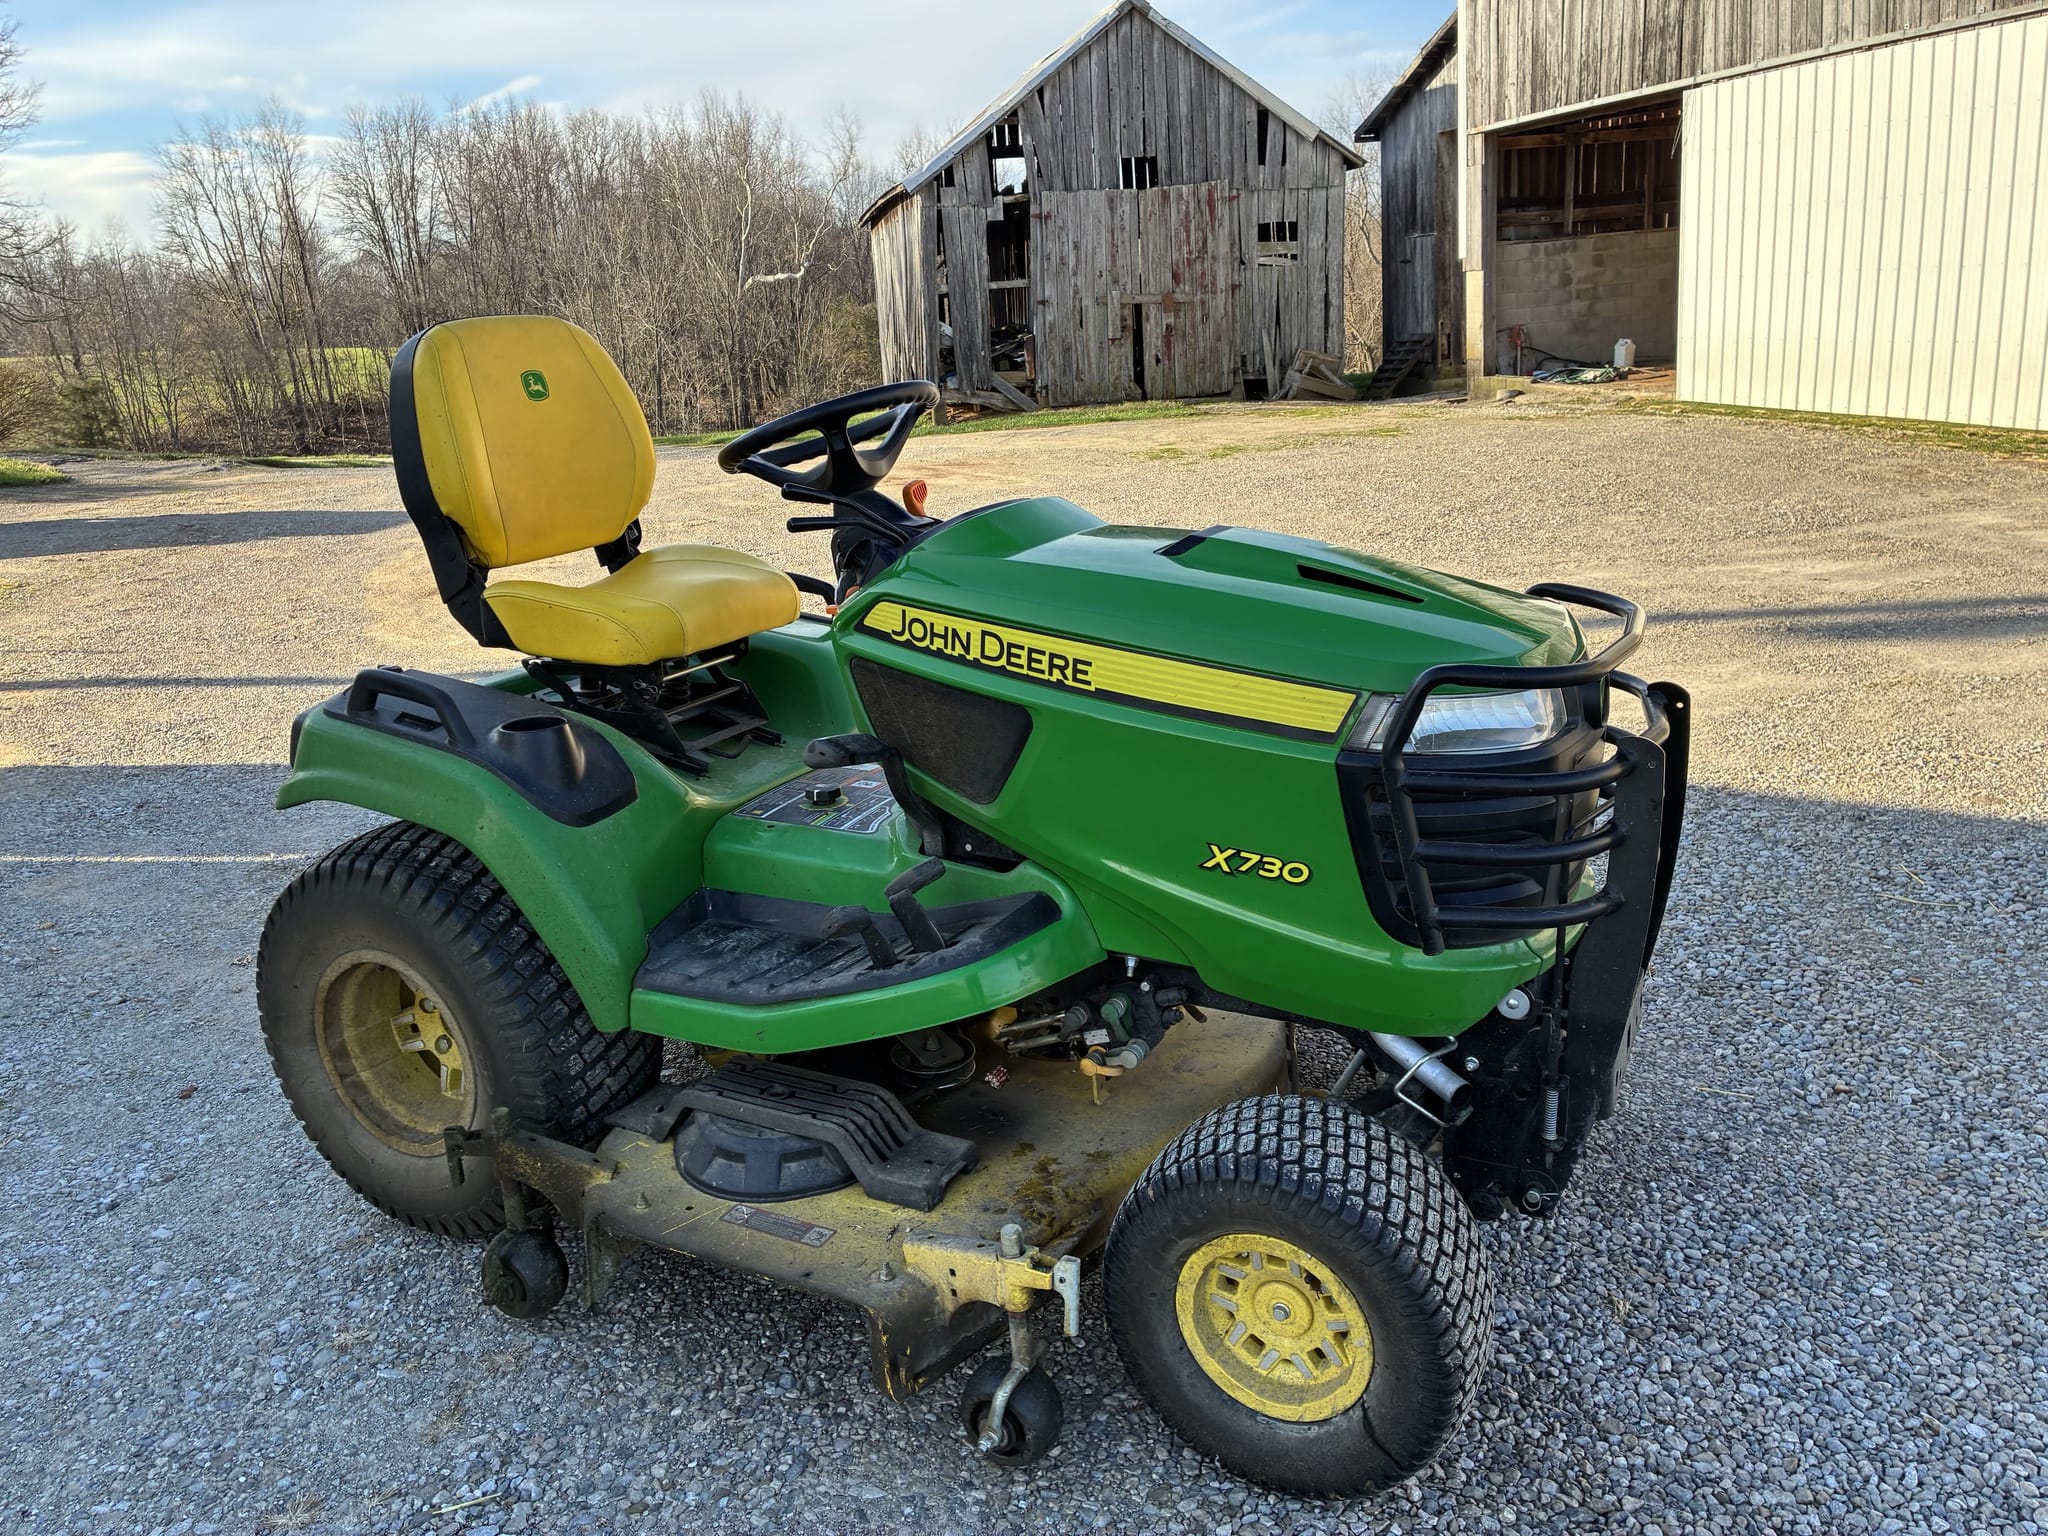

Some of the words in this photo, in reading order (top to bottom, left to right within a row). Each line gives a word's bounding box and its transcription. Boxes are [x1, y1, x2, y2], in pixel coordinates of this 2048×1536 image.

[891, 609, 972, 656] JOHN
[980, 629, 1093, 687] DEERE
[1199, 843, 1312, 885] X730
